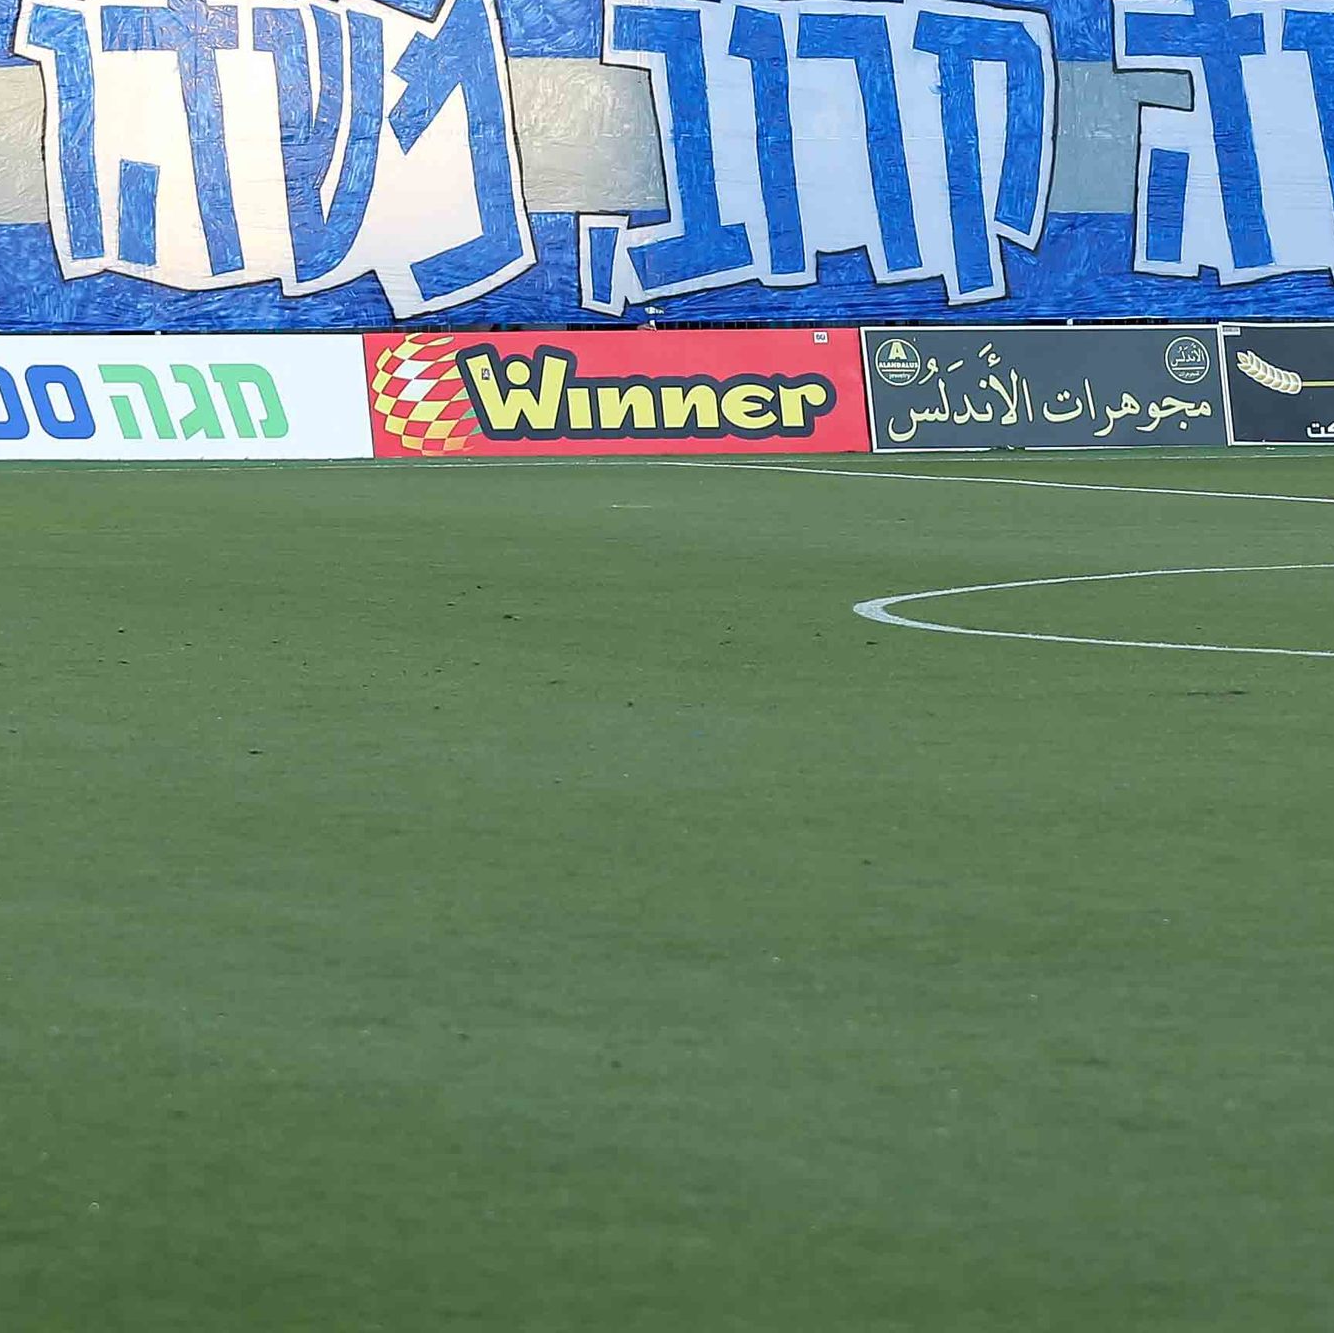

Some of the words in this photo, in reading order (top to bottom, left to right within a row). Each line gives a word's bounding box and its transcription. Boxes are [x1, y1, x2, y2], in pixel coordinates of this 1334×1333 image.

[888, 342, 907, 359] A
[98, 363, 289, 439] מגה
[466, 354, 827, 430] Winner
[1043, 377, 1212, 438] مجوهرات
